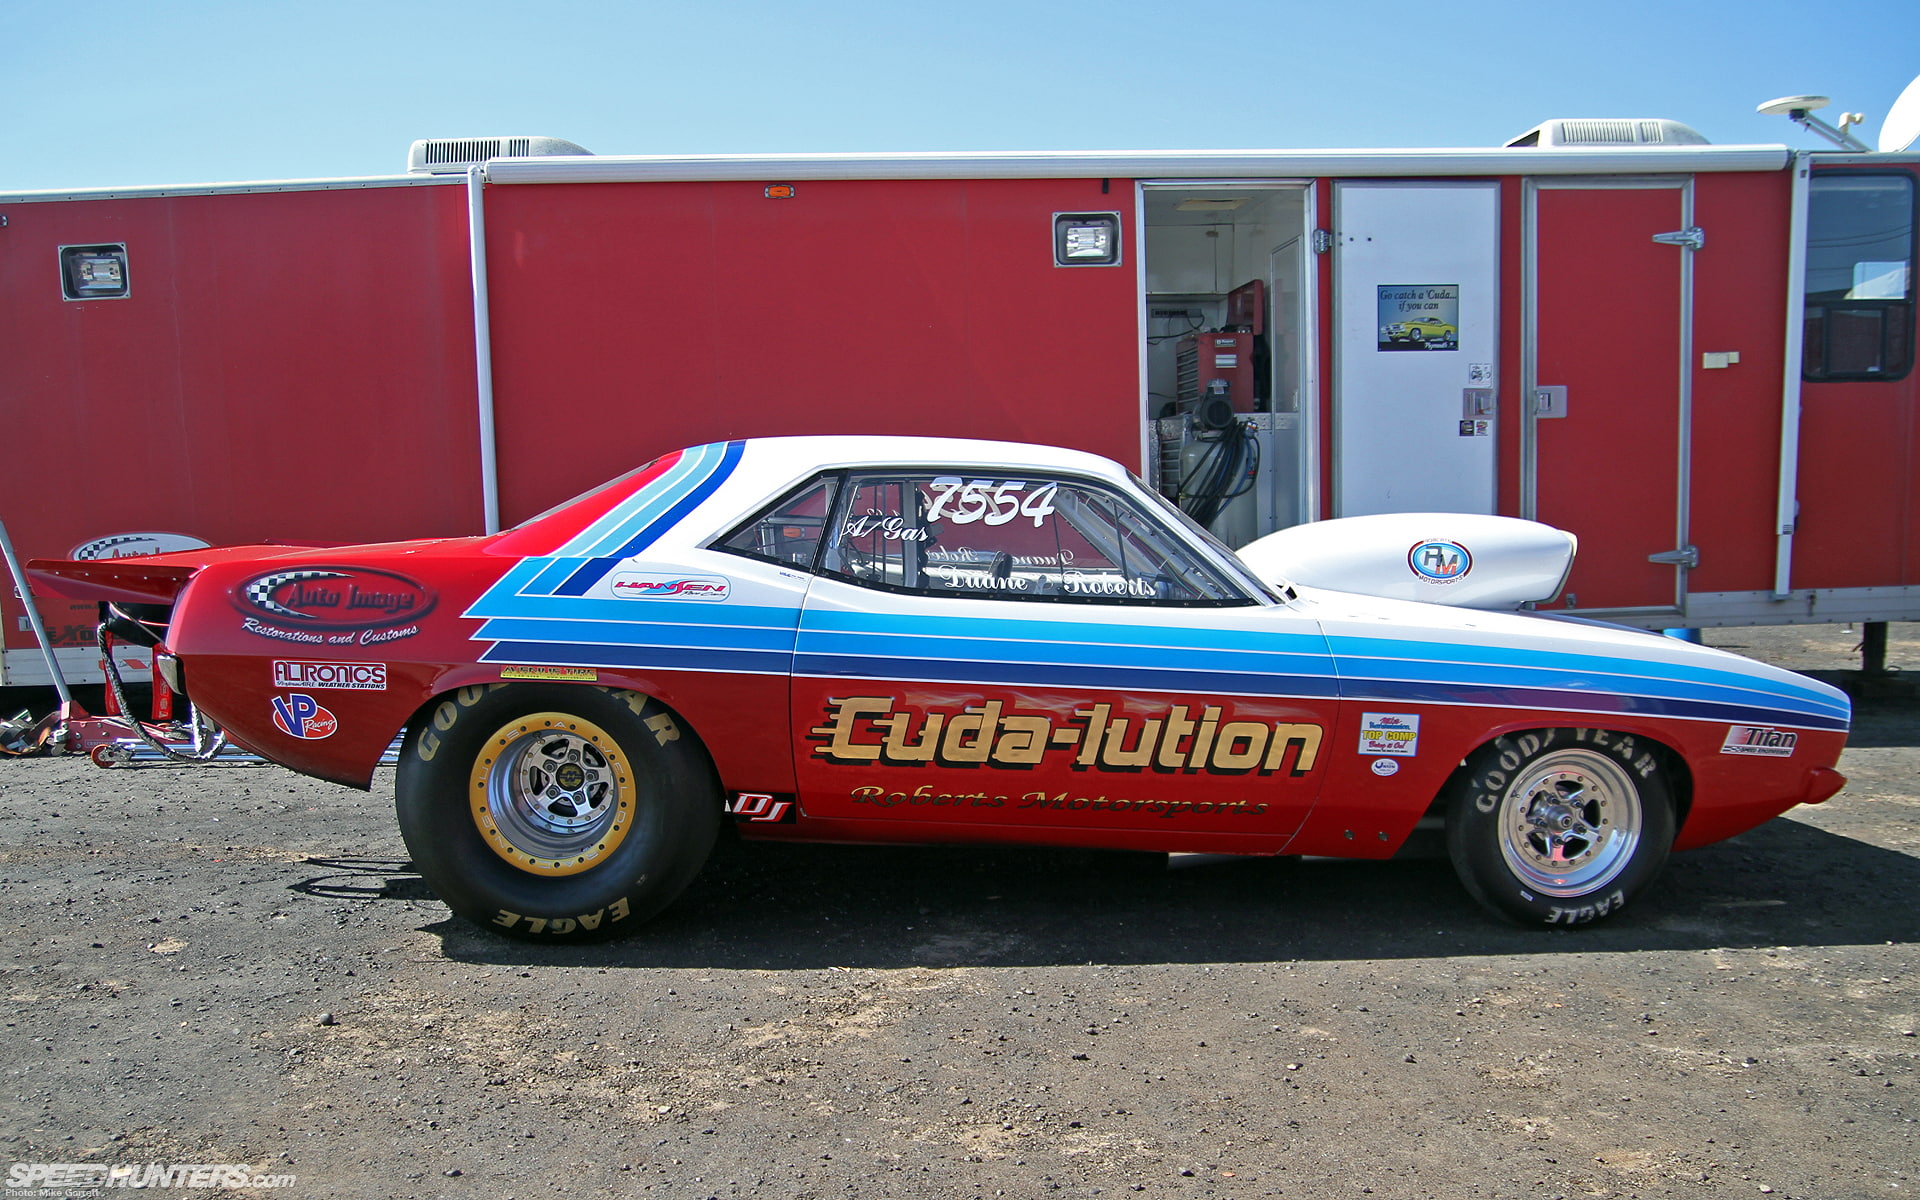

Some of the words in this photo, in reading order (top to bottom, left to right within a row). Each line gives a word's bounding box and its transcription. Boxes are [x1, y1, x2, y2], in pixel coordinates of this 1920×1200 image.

[1381, 290, 1392, 300] Go
[1394, 290, 1416, 300] catch
[1399, 301, 1407, 312] if
[1406, 303, 1422, 312] you
[927, 477, 1057, 527] 7554
[843, 516, 929, 541] A/Gas
[1424, 545, 1458, 575] RM
[614, 580, 727, 594] HANSEN
[938, 565, 1029, 590] Duane
[1062, 570, 1157, 597] Roberts
[1418, 574, 1463, 585] MOTORSPORTS
[284, 584, 342, 608] Auto
[345, 584, 415, 614] Image
[242, 617, 324, 644] Restorations
[328, 632, 355, 645] and
[359, 625, 419, 646] Customs
[272, 693, 318, 738] VP
[304, 719, 337, 733] Racing
[812, 697, 1324, 773] Cuda-lution
[1363, 730, 1383, 740] TOP
[1385, 731, 1417, 741] COMP
[1744, 727, 1798, 748] Titan
[732, 792, 794, 822] DJ
[851, 785, 1009, 809] Roberts
[1017, 791, 1270, 818] Motorsports
[492, 897, 630, 935] EAGLE
[1544, 889, 1625, 924] EAGLE
